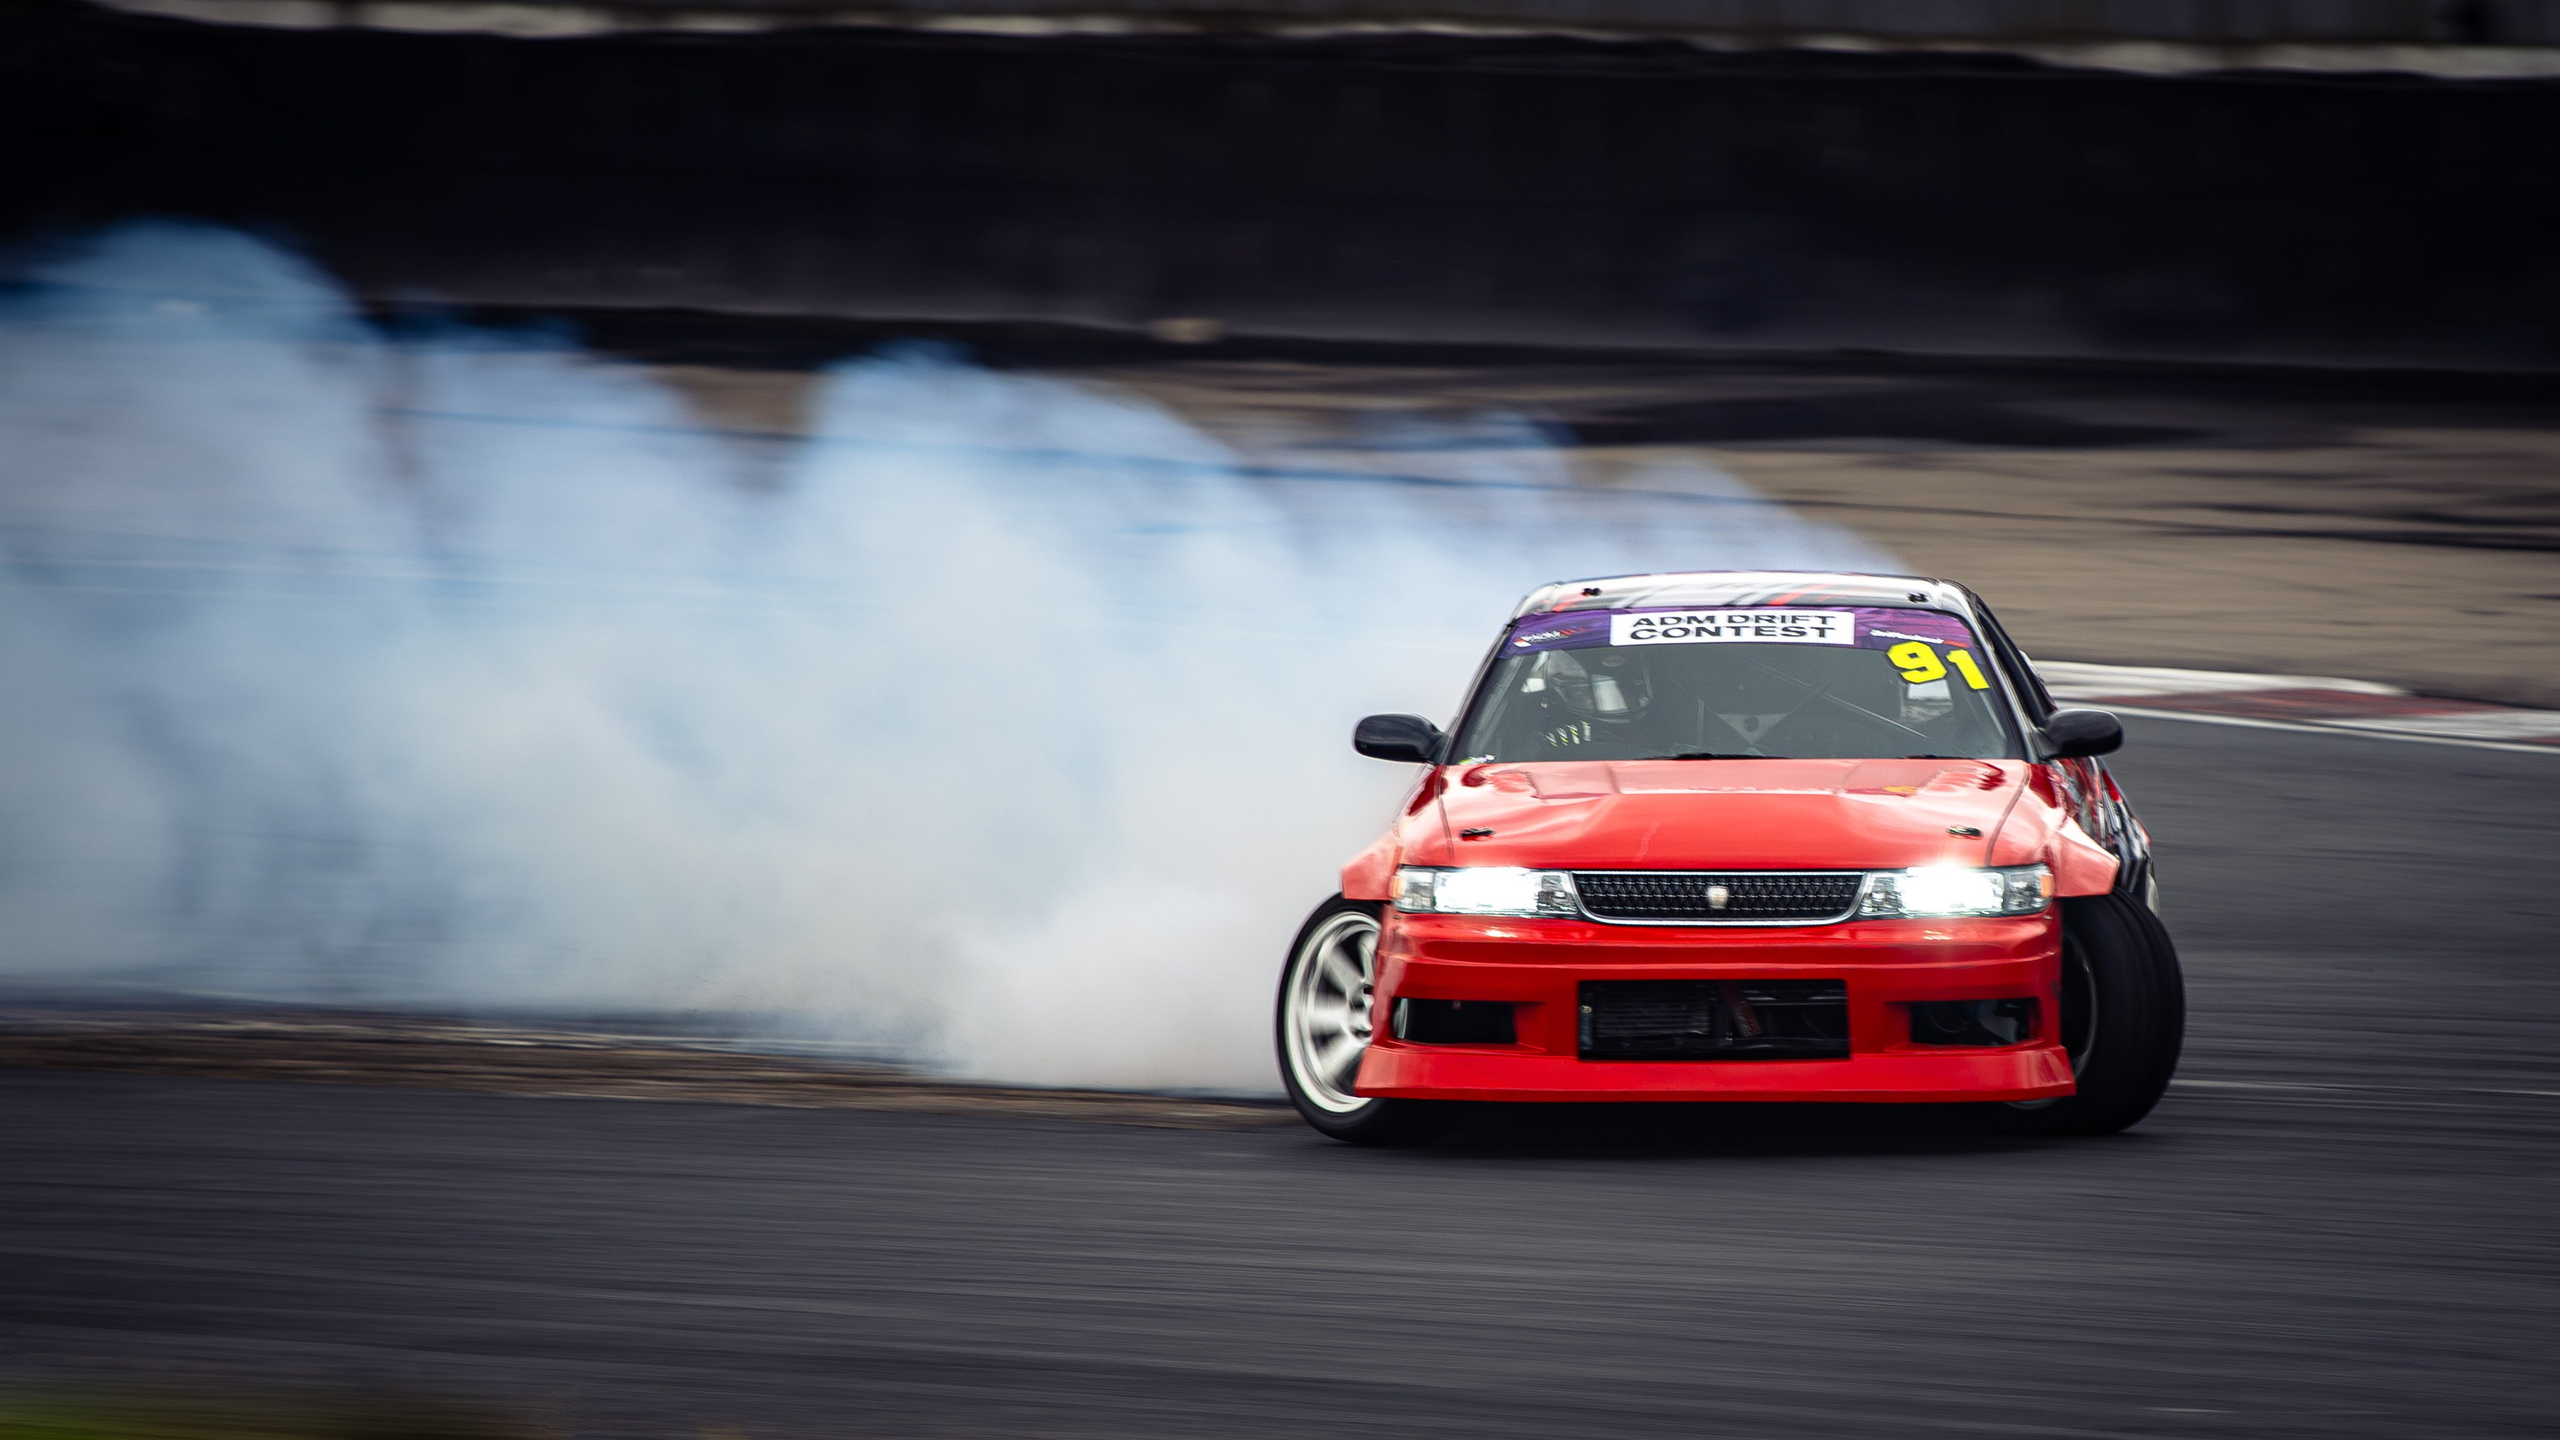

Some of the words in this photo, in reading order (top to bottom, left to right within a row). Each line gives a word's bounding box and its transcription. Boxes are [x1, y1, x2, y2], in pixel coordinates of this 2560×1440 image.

[1633, 615, 1716, 627] ADM
[1727, 615, 1836, 625] DRIFT
[1630, 626, 1836, 640] CONTEST
[1887, 641, 1990, 690] 91
